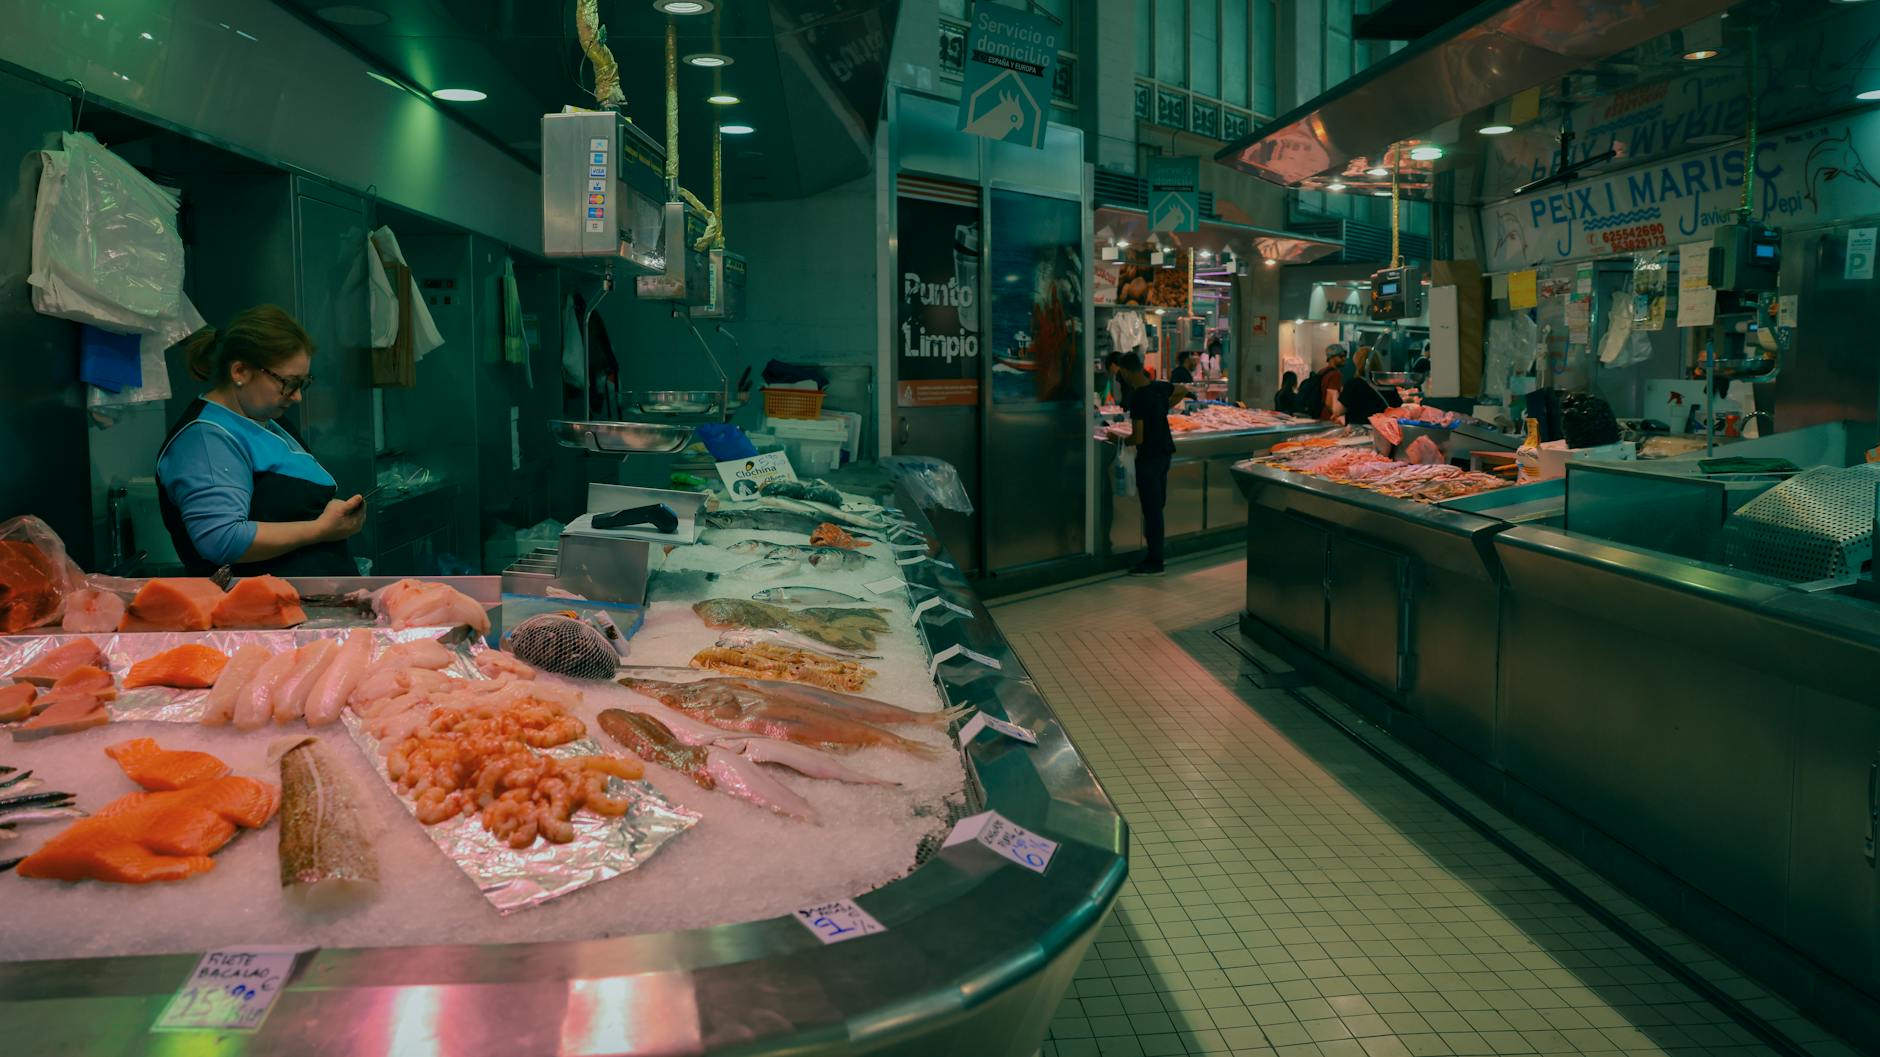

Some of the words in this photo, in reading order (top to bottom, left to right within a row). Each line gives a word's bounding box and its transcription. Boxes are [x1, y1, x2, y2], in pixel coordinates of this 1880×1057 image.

[978, 12, 1042, 44] Servicio
[1046, 35, 1055, 48] a
[977, 34, 1050, 67] domicilio
[988, 56, 1010, 68] ESPAÑA
[1015, 62, 1037, 74] EUROPA
[1530, 187, 1597, 228] PEIX
[1605, 182, 1616, 212] I
[1628, 142, 1783, 207] MARISC
[1603, 223, 1664, 243] 625542690
[904, 271, 973, 307] Punto
[902, 322, 978, 364] Limpio
[736, 465, 777, 478] Clochina
[207, 952, 257, 966] FILETE
[198, 968, 270, 978] BACALAO
